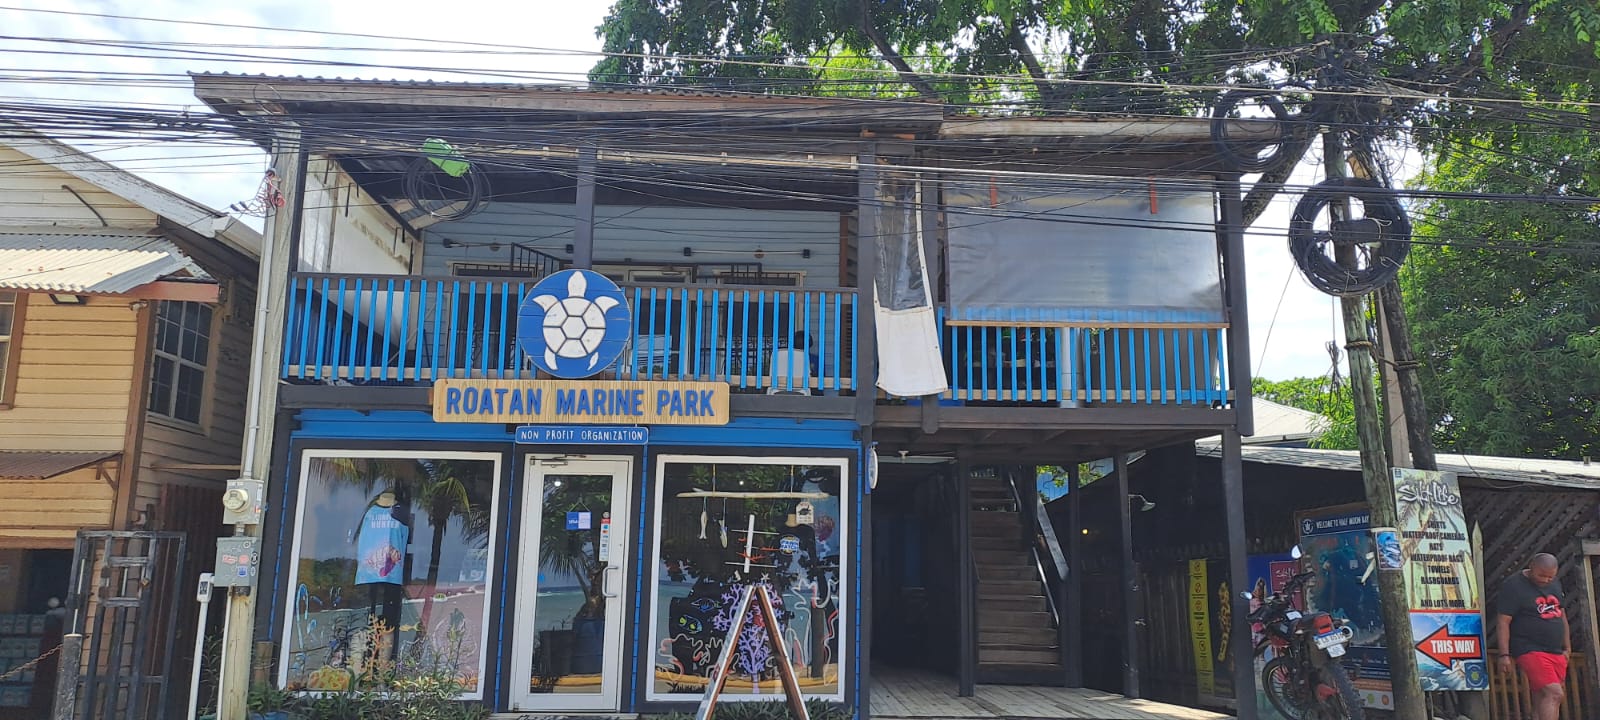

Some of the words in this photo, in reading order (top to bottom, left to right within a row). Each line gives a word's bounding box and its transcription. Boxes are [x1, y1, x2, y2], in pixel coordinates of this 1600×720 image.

[446, 387, 542, 415] ROATAN
[556, 388, 644, 416] MARINE
[656, 389, 715, 417] PARK
[521, 431, 539, 440] NON
[546, 431, 574, 441] PROFIT
[581, 431, 643, 442] ORGANIZATION
[1402, 531, 1440, 540] WATERPROOF
[1440, 532, 1466, 541] CAMERAS
[1410, 554, 1447, 562] WATERPROOF
[1427, 566, 1450, 574] TOWELS
[1421, 600, 1433, 608] AND
[1449, 600, 1465, 608] MORE
[1430, 639, 1454, 654] THIS
[1454, 639, 1475, 654] WAY
